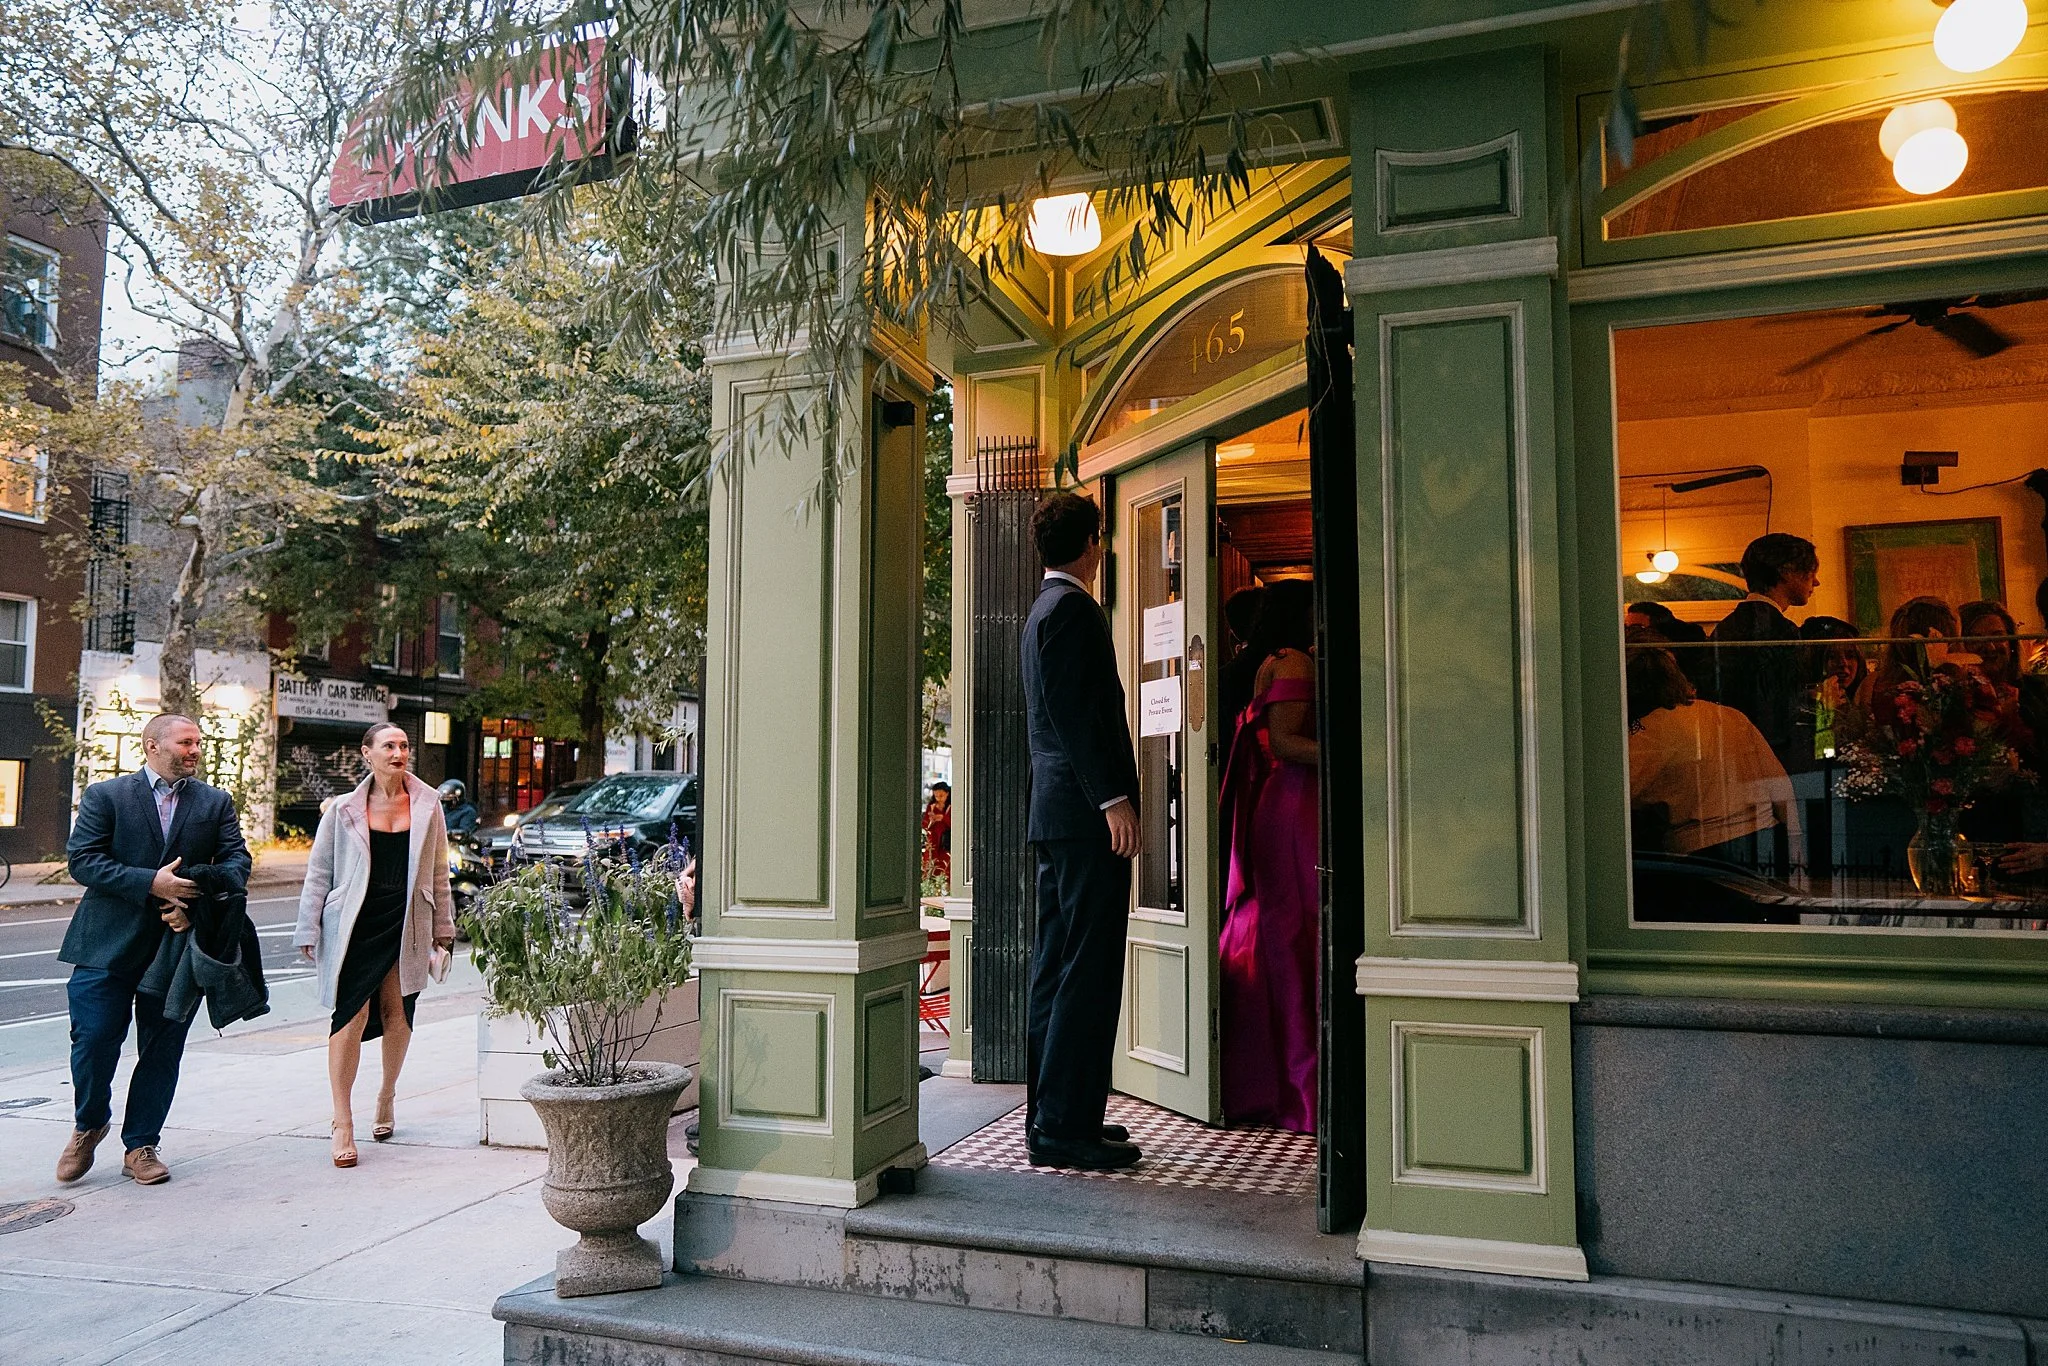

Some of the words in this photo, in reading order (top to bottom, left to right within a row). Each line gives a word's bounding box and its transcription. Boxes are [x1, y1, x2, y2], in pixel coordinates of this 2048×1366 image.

[278, 678, 323, 696] BATTERY
[327, 684, 347, 699] CAR
[350, 687, 386, 703] SERVICE
